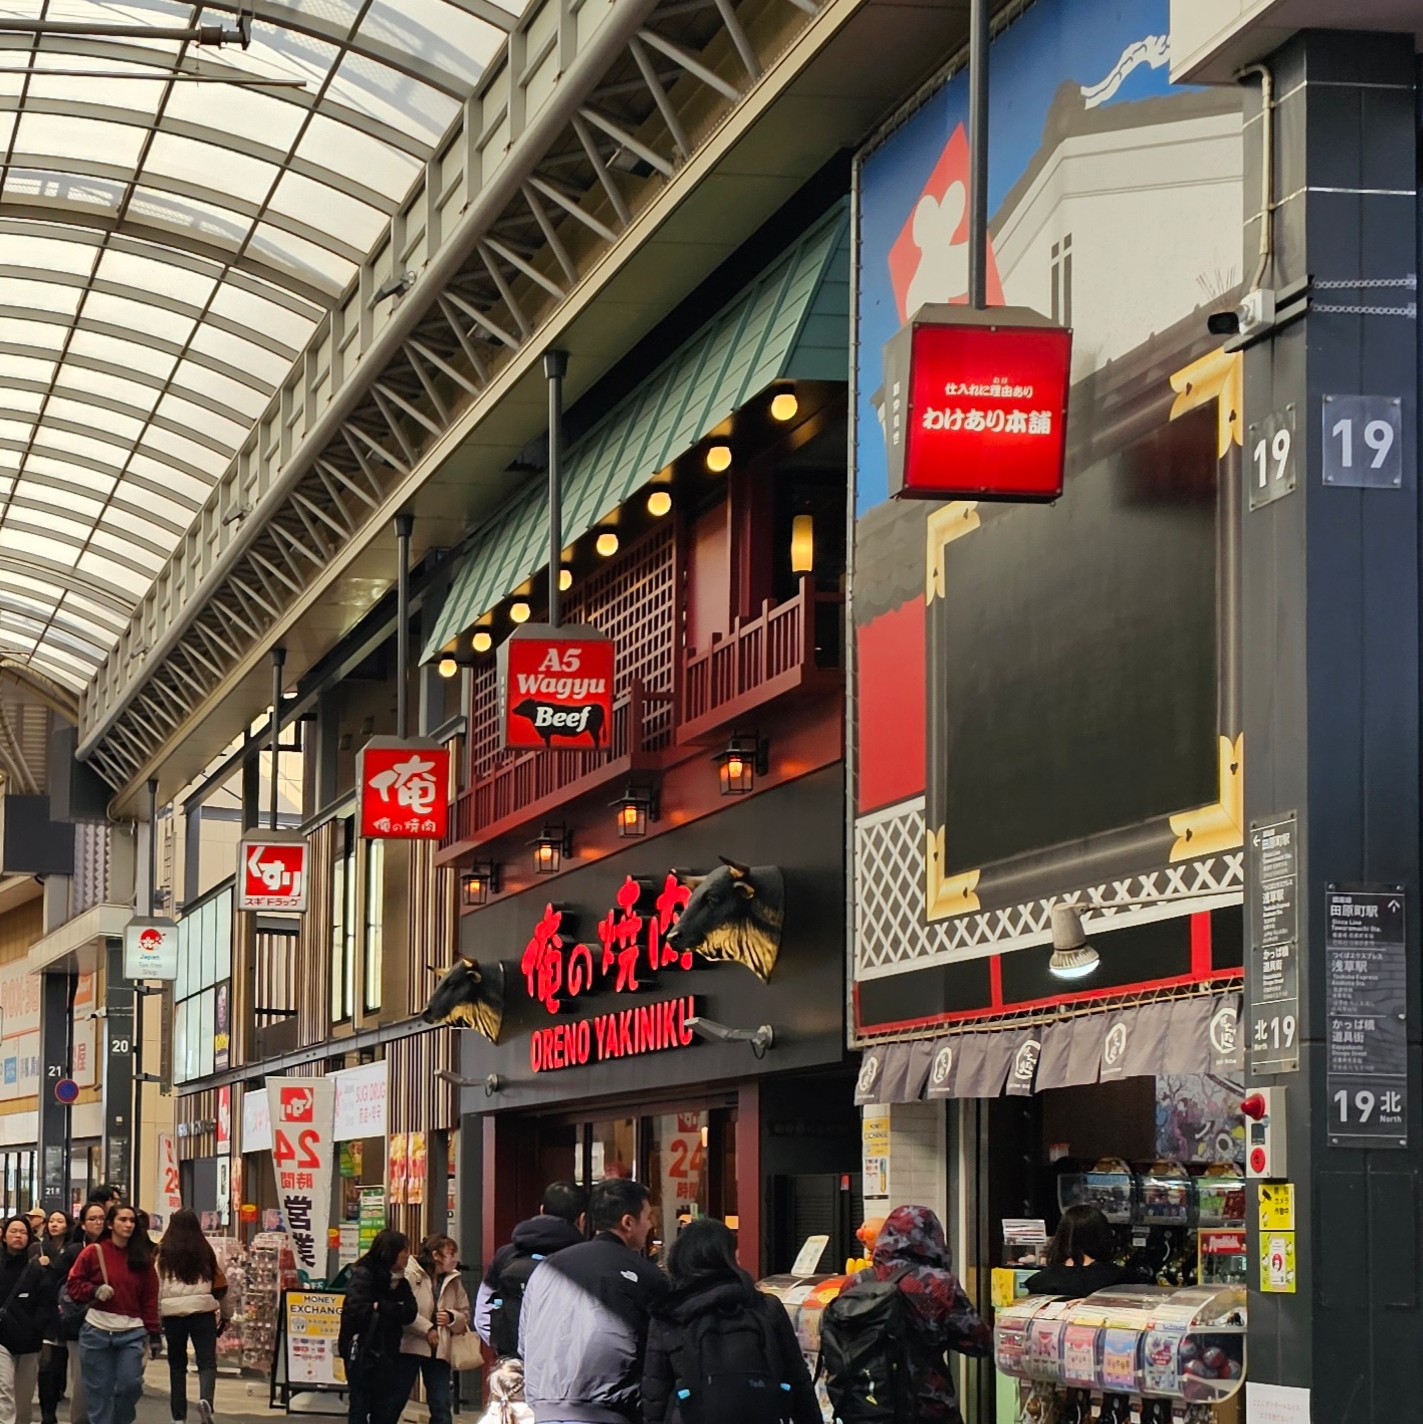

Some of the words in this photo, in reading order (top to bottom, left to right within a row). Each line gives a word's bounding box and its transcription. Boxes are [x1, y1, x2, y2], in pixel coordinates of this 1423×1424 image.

[945, 382, 1034, 398] 仕入れに理由あり
[922, 406, 1052, 435] わけあり本舗
[1331, 418, 1394, 469] 19
[1253, 428, 1291, 489] 19
[538, 648, 582, 672] A5
[516, 673, 606, 699] Wagyu
[534, 706, 592, 732] Beef
[368, 754, 437, 814] 俺
[372, 817, 436, 833] 俺の焼肉
[247, 845, 302, 896] くすり
[1330, 905, 1378, 917] 田原町駅
[1332, 960, 1367, 972] 浅草駅
[531, 1019, 590, 1073] ORENO
[594, 995, 694, 1061] YAKINIKU
[1254, 1019, 1268, 1040] 北
[1271, 1015, 1295, 1049] 19
[1332, 1031, 1364, 1043] 道具街
[111, 1040, 129, 1053] 20
[48, 1065, 61, 1077] 21
[1334, 1090, 1375, 1123] 19
[1380, 1091, 1401, 1113] 北
[1380, 1115, 1401, 1123] North
[290, 1305, 344, 1315] EXCHANG
